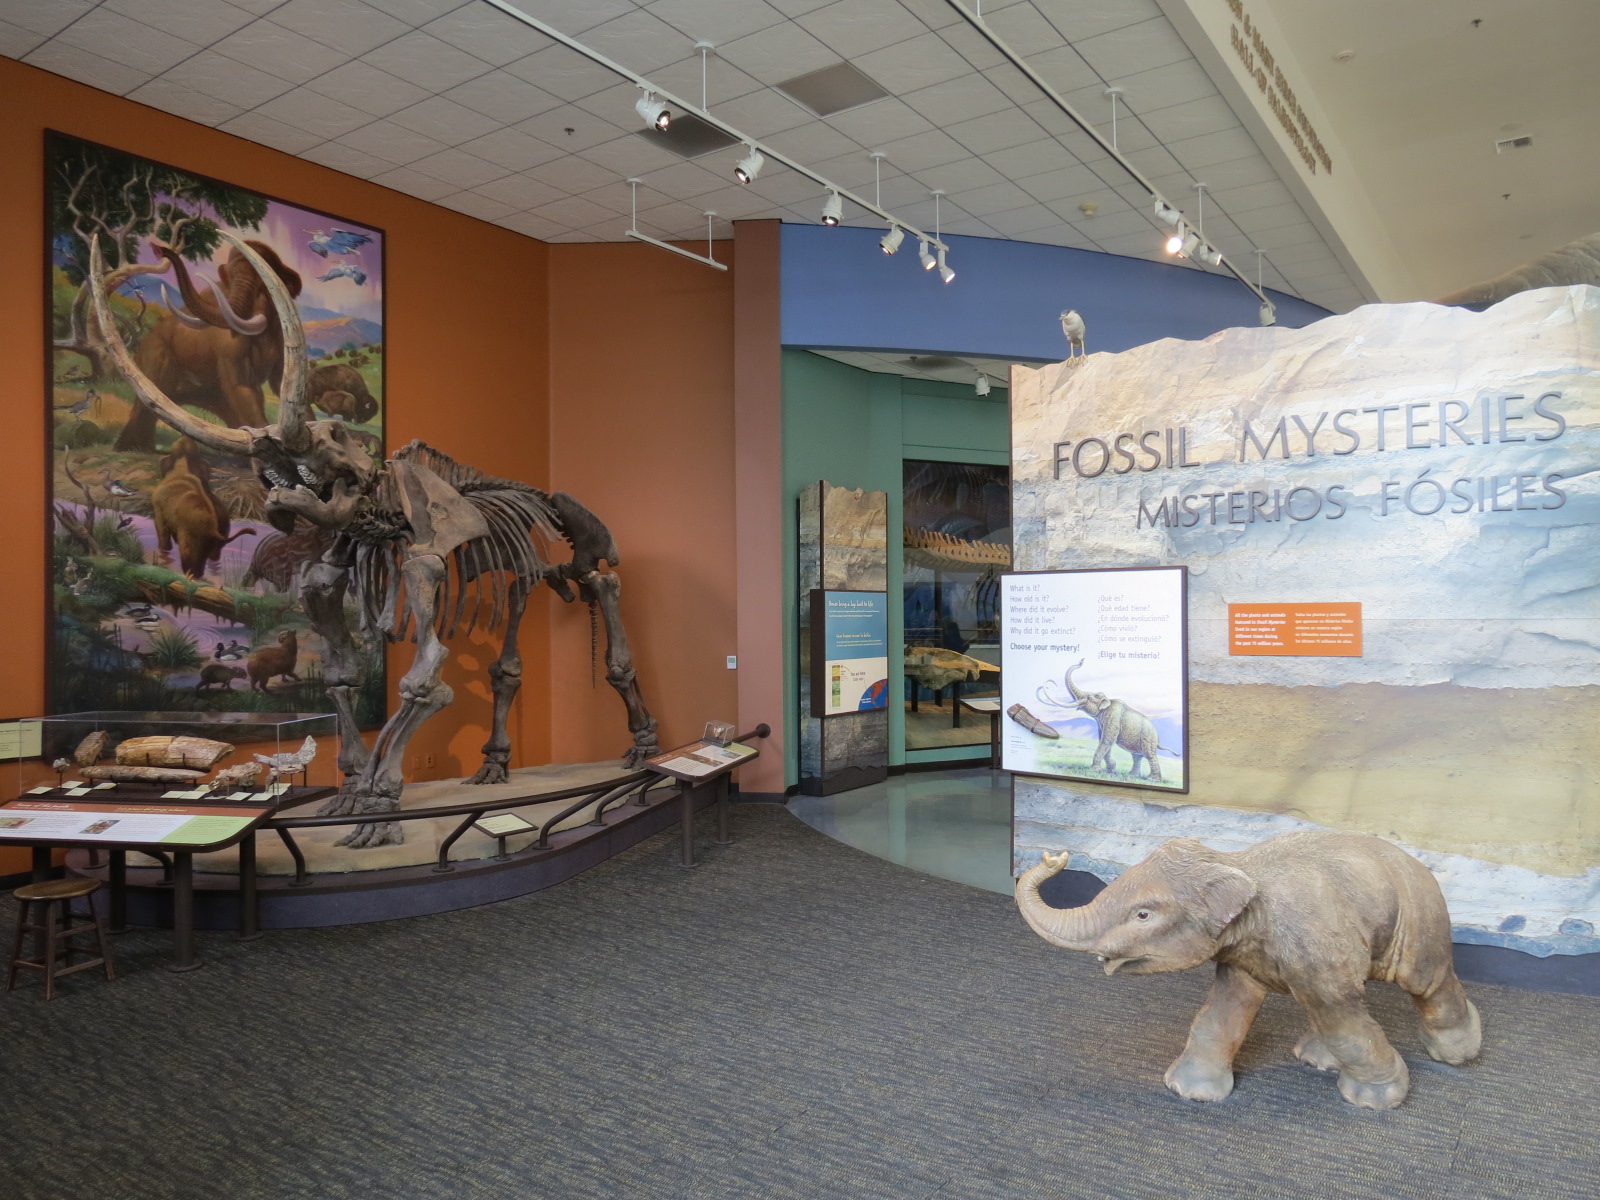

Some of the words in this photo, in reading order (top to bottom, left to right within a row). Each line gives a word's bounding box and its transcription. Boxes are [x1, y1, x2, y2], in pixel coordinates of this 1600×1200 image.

[1053, 426, 1200, 480] FOSSIL
[1240, 391, 1567, 463] MYSTERIES
[1136, 484, 1347, 530] MISTERIOS
[1380, 469, 1568, 517] FÓSILES
[1010, 627, 1021, 635] Why
[1050, 644, 1080, 653] mystery!
